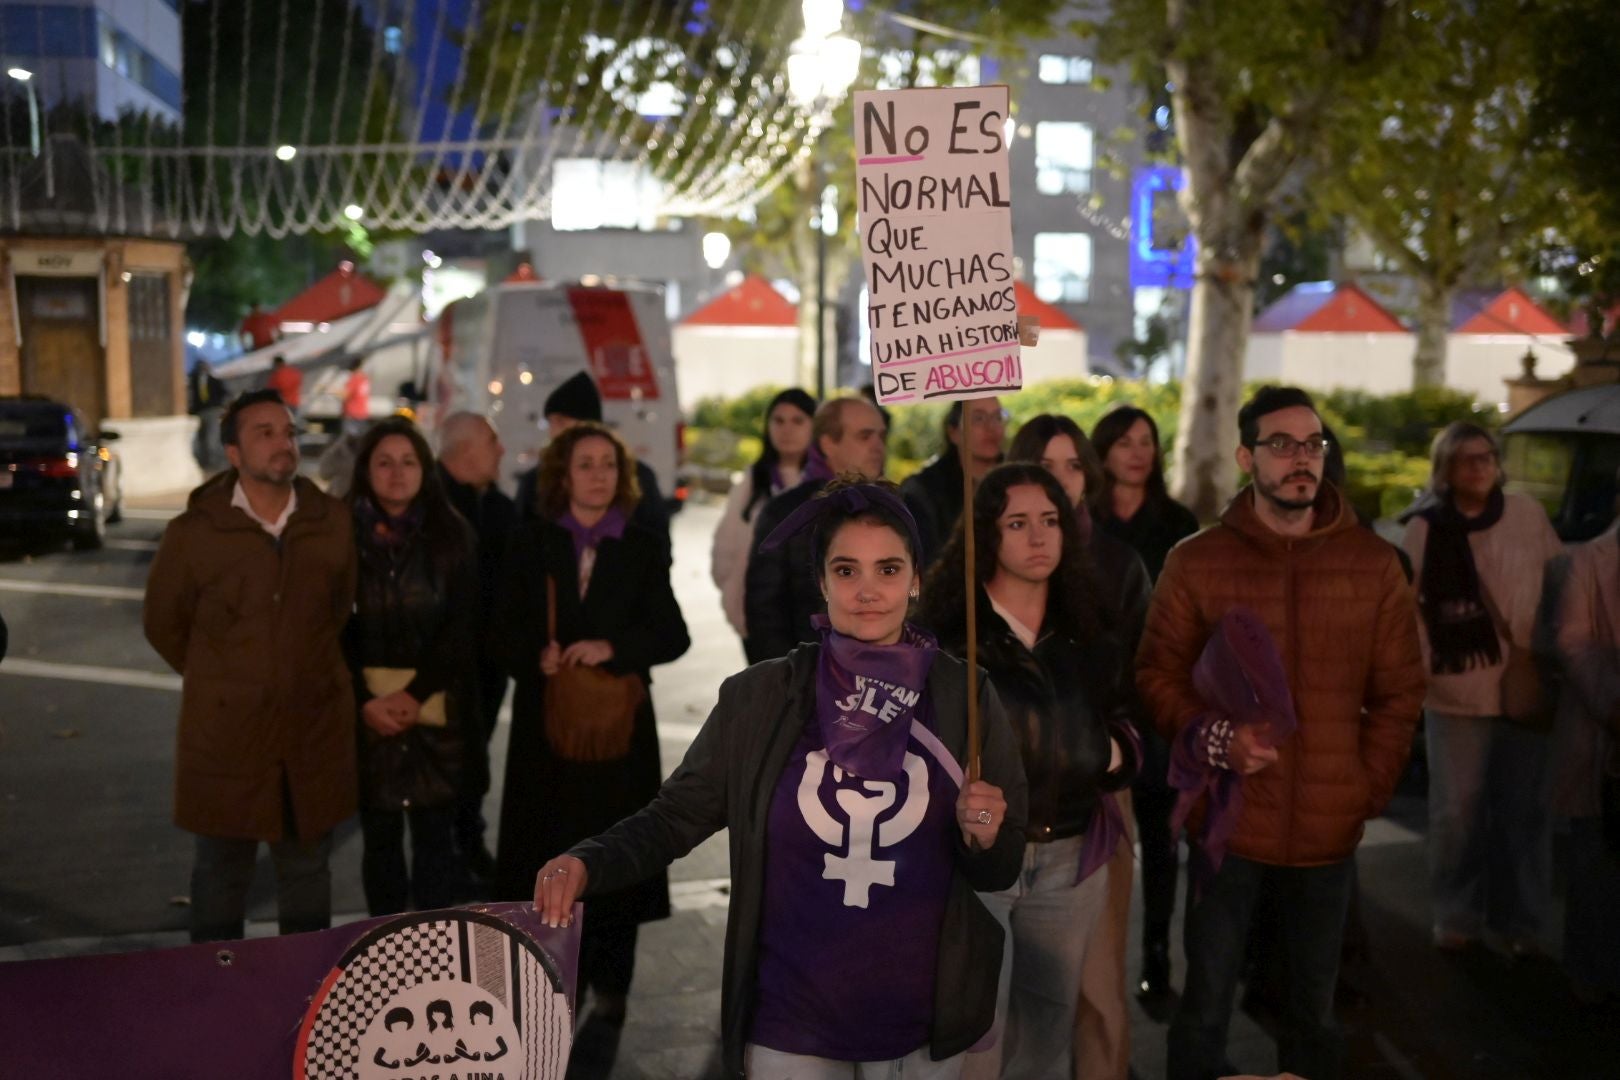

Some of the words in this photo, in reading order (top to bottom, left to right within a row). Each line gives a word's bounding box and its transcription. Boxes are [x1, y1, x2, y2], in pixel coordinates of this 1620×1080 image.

[948, 101, 1002, 153] ES
[861, 172, 1010, 214] NORMAL
[868, 218, 928, 258] QUE
[872, 252, 1010, 294] MUCHAS
[871, 287, 1015, 329] TENGAMOS
[876, 334, 932, 363] UNA
[878, 372, 916, 396] DE
